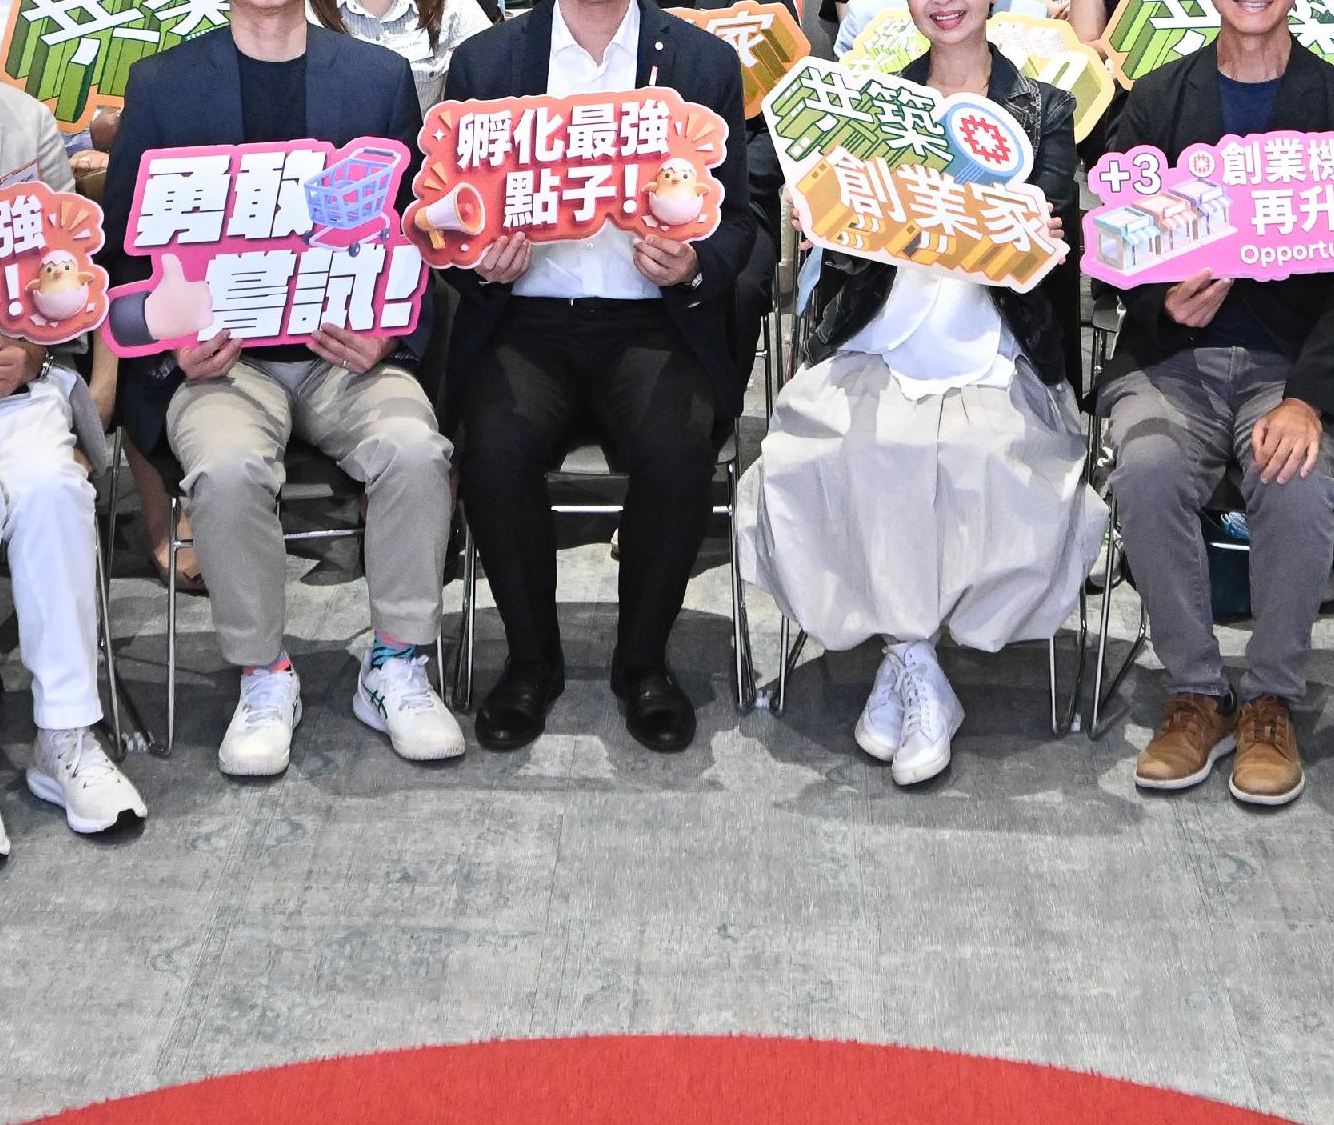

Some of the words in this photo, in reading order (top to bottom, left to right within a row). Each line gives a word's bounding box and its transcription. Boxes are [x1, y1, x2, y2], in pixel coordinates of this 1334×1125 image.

[457, 100, 672, 169] 孵化最強
[797, 66, 954, 162] 共築
[132, 153, 327, 247] 勇敢
[833, 153, 1052, 253] 創業家
[1099, 154, 1163, 194] +3
